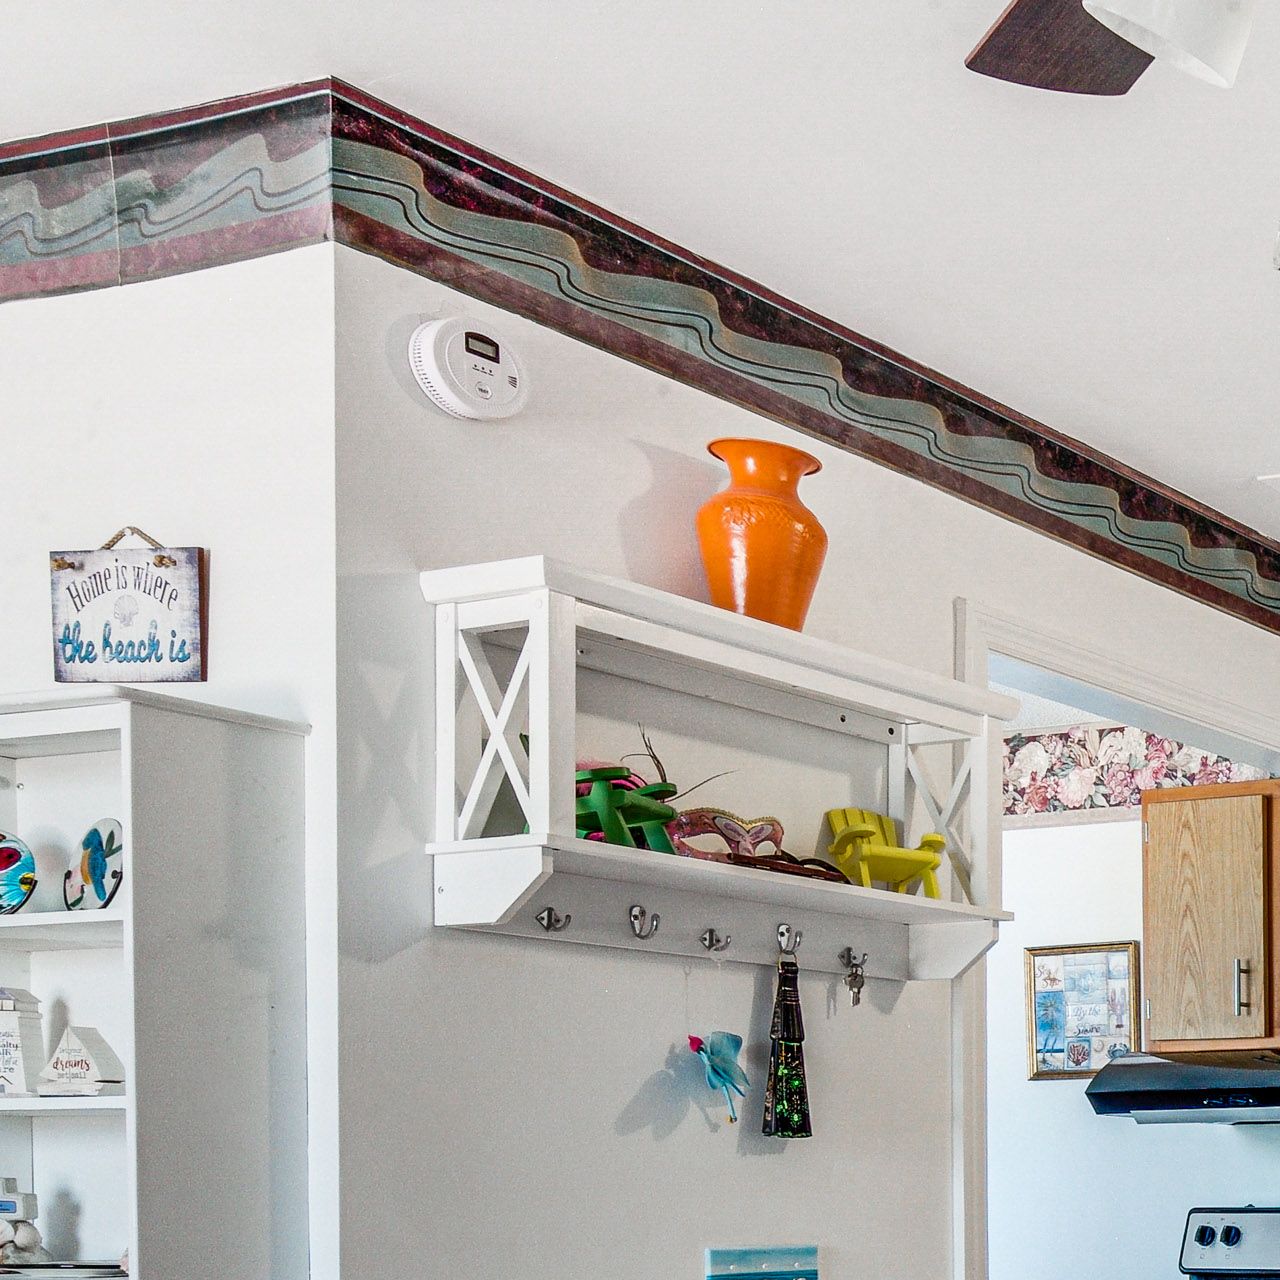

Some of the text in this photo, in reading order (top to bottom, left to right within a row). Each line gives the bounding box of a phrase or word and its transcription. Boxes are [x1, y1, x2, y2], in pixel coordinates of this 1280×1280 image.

[66, 558, 179, 612] Home is where
[59, 619, 191, 664] the beach is
[53, 1057, 90, 1071] dreams
